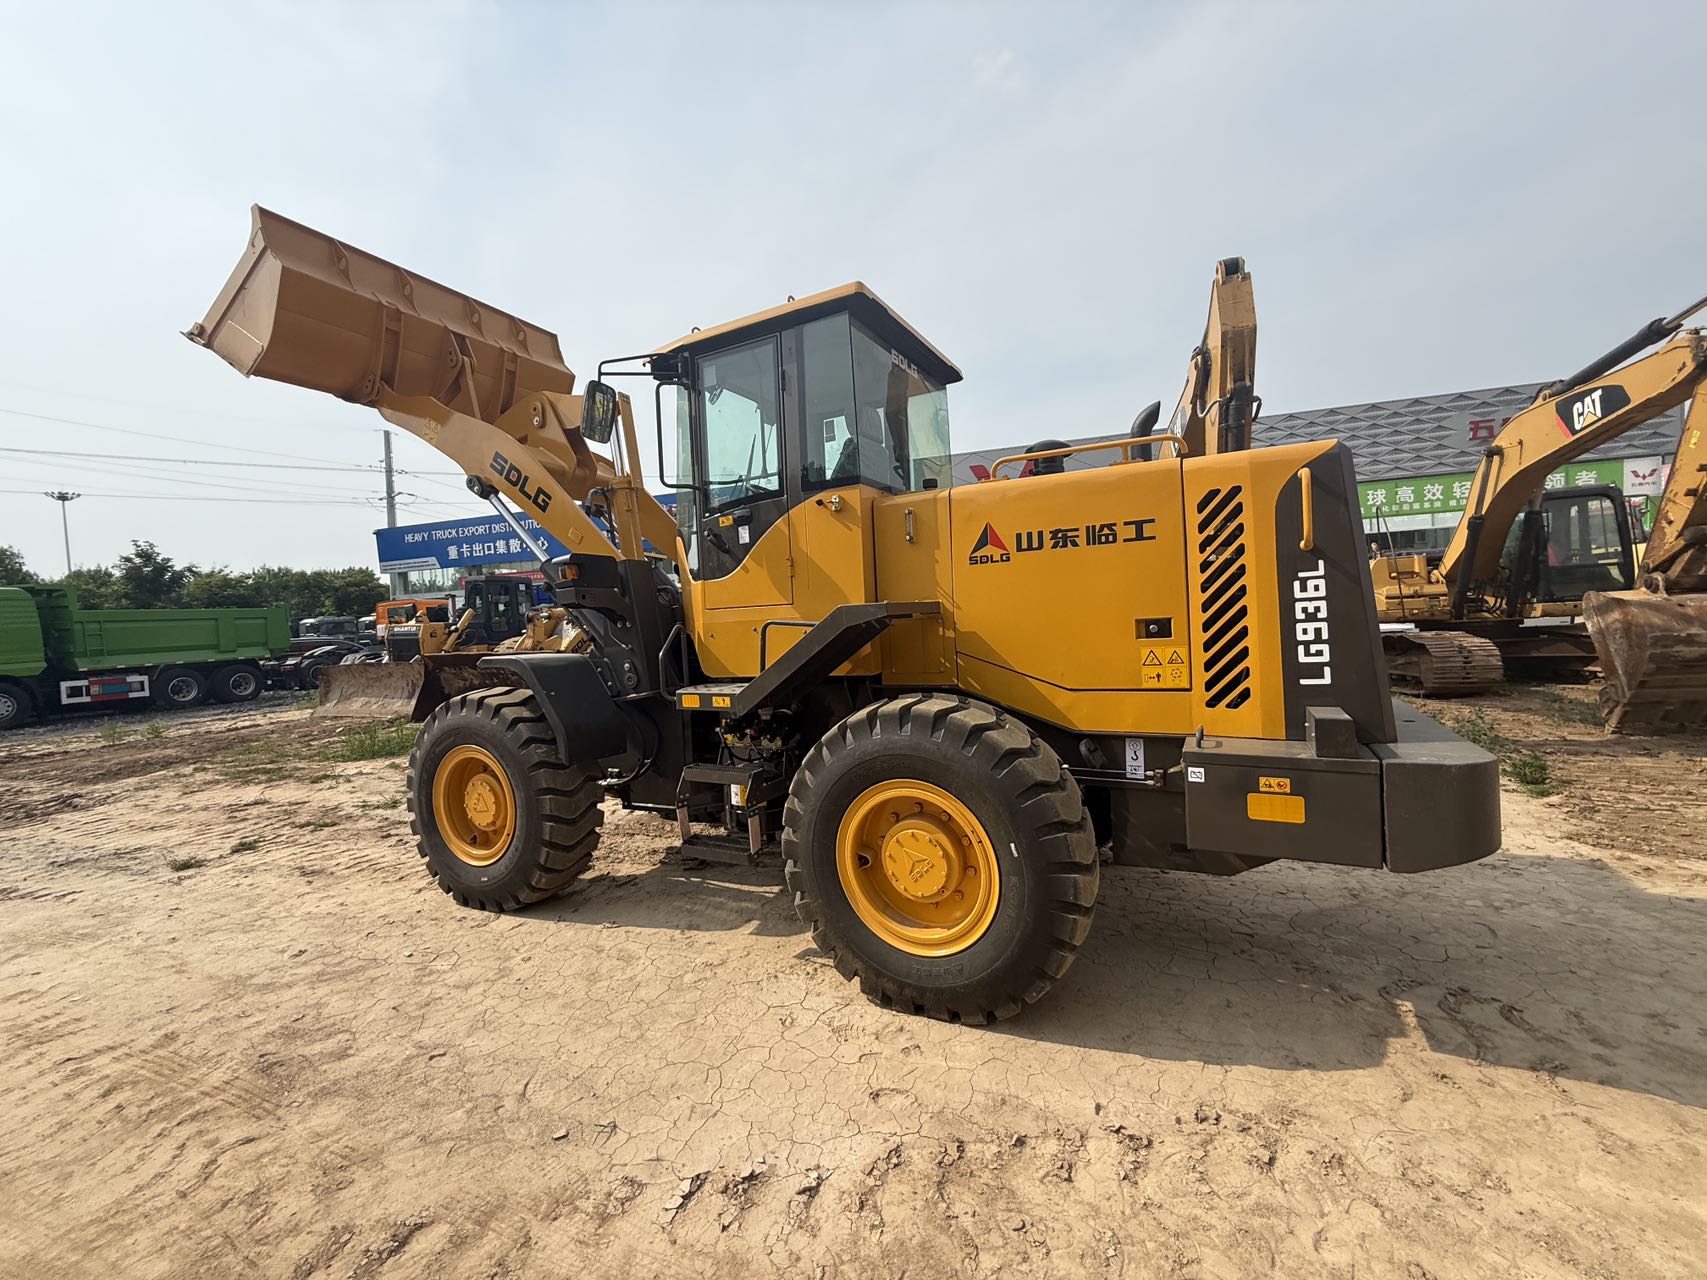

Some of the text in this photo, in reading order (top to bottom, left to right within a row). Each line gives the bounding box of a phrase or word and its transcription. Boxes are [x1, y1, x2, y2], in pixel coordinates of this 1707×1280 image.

[890, 348, 918, 379] SDLG
[1572, 388, 1602, 431] CAT
[1467, 416, 1511, 441] 五
[489, 450, 552, 513] SDLG
[1366, 481, 1472, 506] 球高效轻
[1544, 470, 1598, 490] 领者
[404, 519, 543, 543] HEAVY TRUCK EXPORT DISTUTIO
[1015, 517, 1157, 553] 山东临工
[968, 552, 1011, 566] SDLG
[1293, 559, 1331, 685] LG936L
